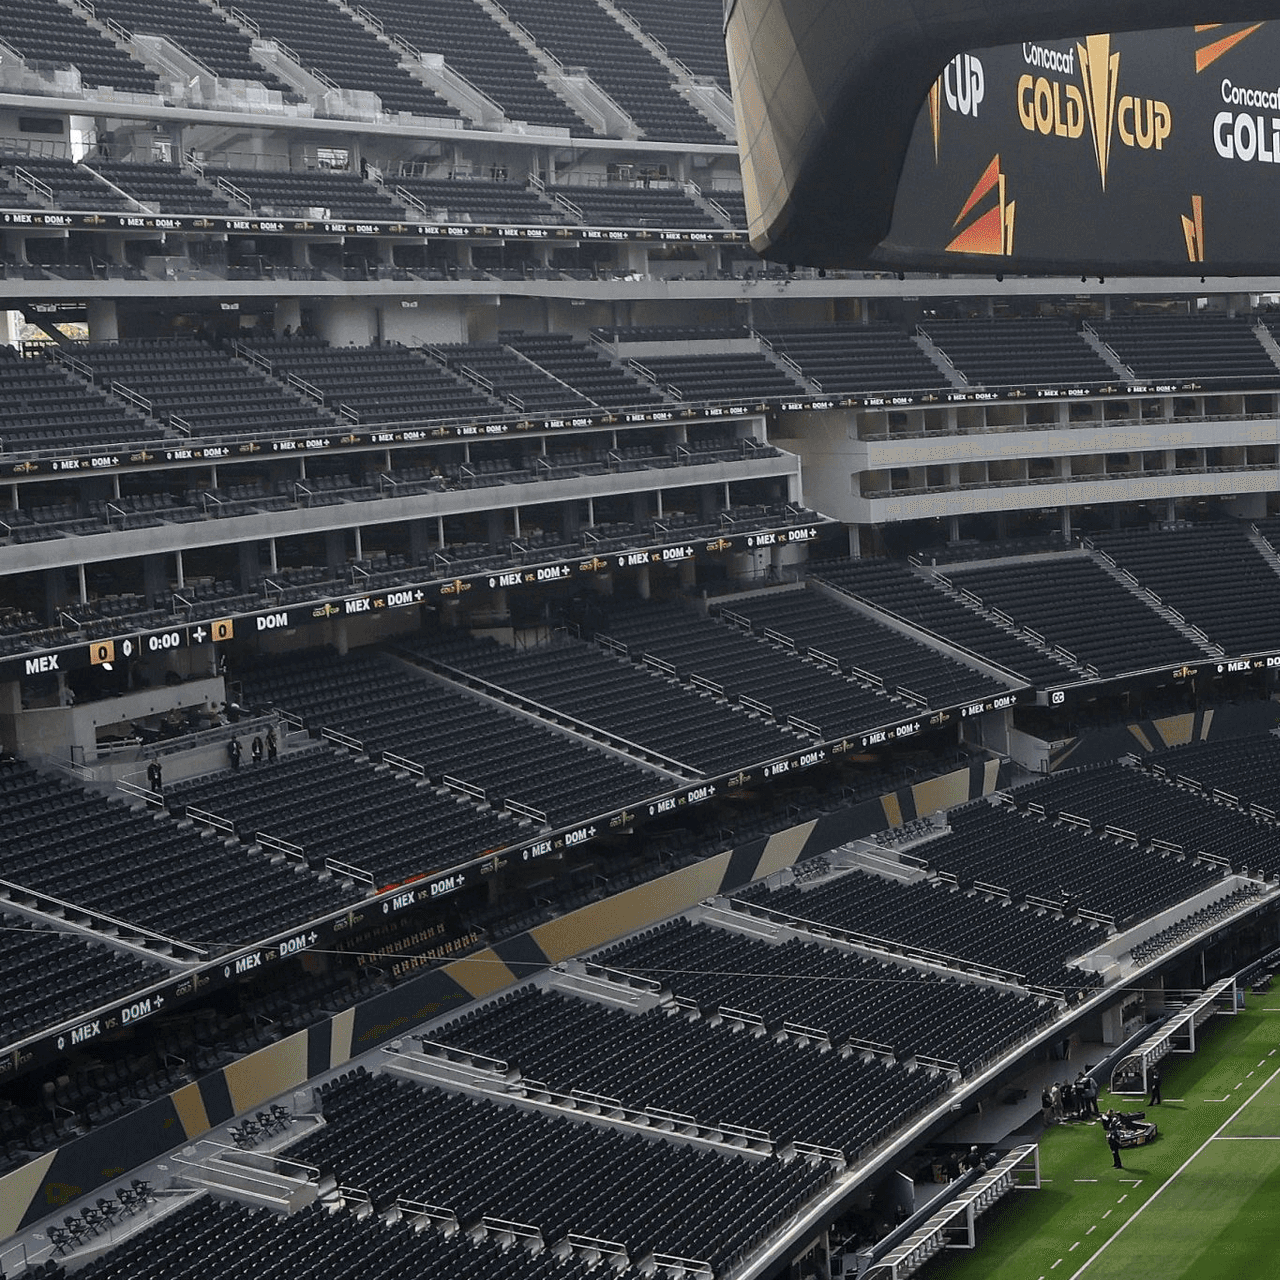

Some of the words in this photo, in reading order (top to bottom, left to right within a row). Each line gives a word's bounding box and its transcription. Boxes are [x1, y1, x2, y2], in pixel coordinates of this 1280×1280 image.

[1022, 41, 1074, 75] Concacaf
[944, 54, 985, 118] CUP
[1017, 73, 1084, 139] GOLD
[1117, 95, 1172, 151] CUP
[175, 451, 191, 459] MEX
[204, 448, 223, 457] DOM
[757, 534, 775, 545] MEX
[789, 529, 810, 541] DOM
[627, 552, 649, 565] MEX
[663, 547, 686, 561] DOM
[499, 571, 521, 586] MEX
[538, 567, 560, 579] DOM
[344, 597, 370, 613] MEX
[388, 591, 414, 605] DOM
[26, 655, 59, 674] MEX
[149, 633, 179, 650] 0:00
[257, 613, 287, 630] DOM
[392, 892, 414, 910] MEX
[431, 877, 455, 895] DOM
[234, 952, 261, 973] MEX
[280, 935, 307, 956] DOM
[71, 1021, 100, 1044] MEX
[122, 999, 151, 1022] DOM
